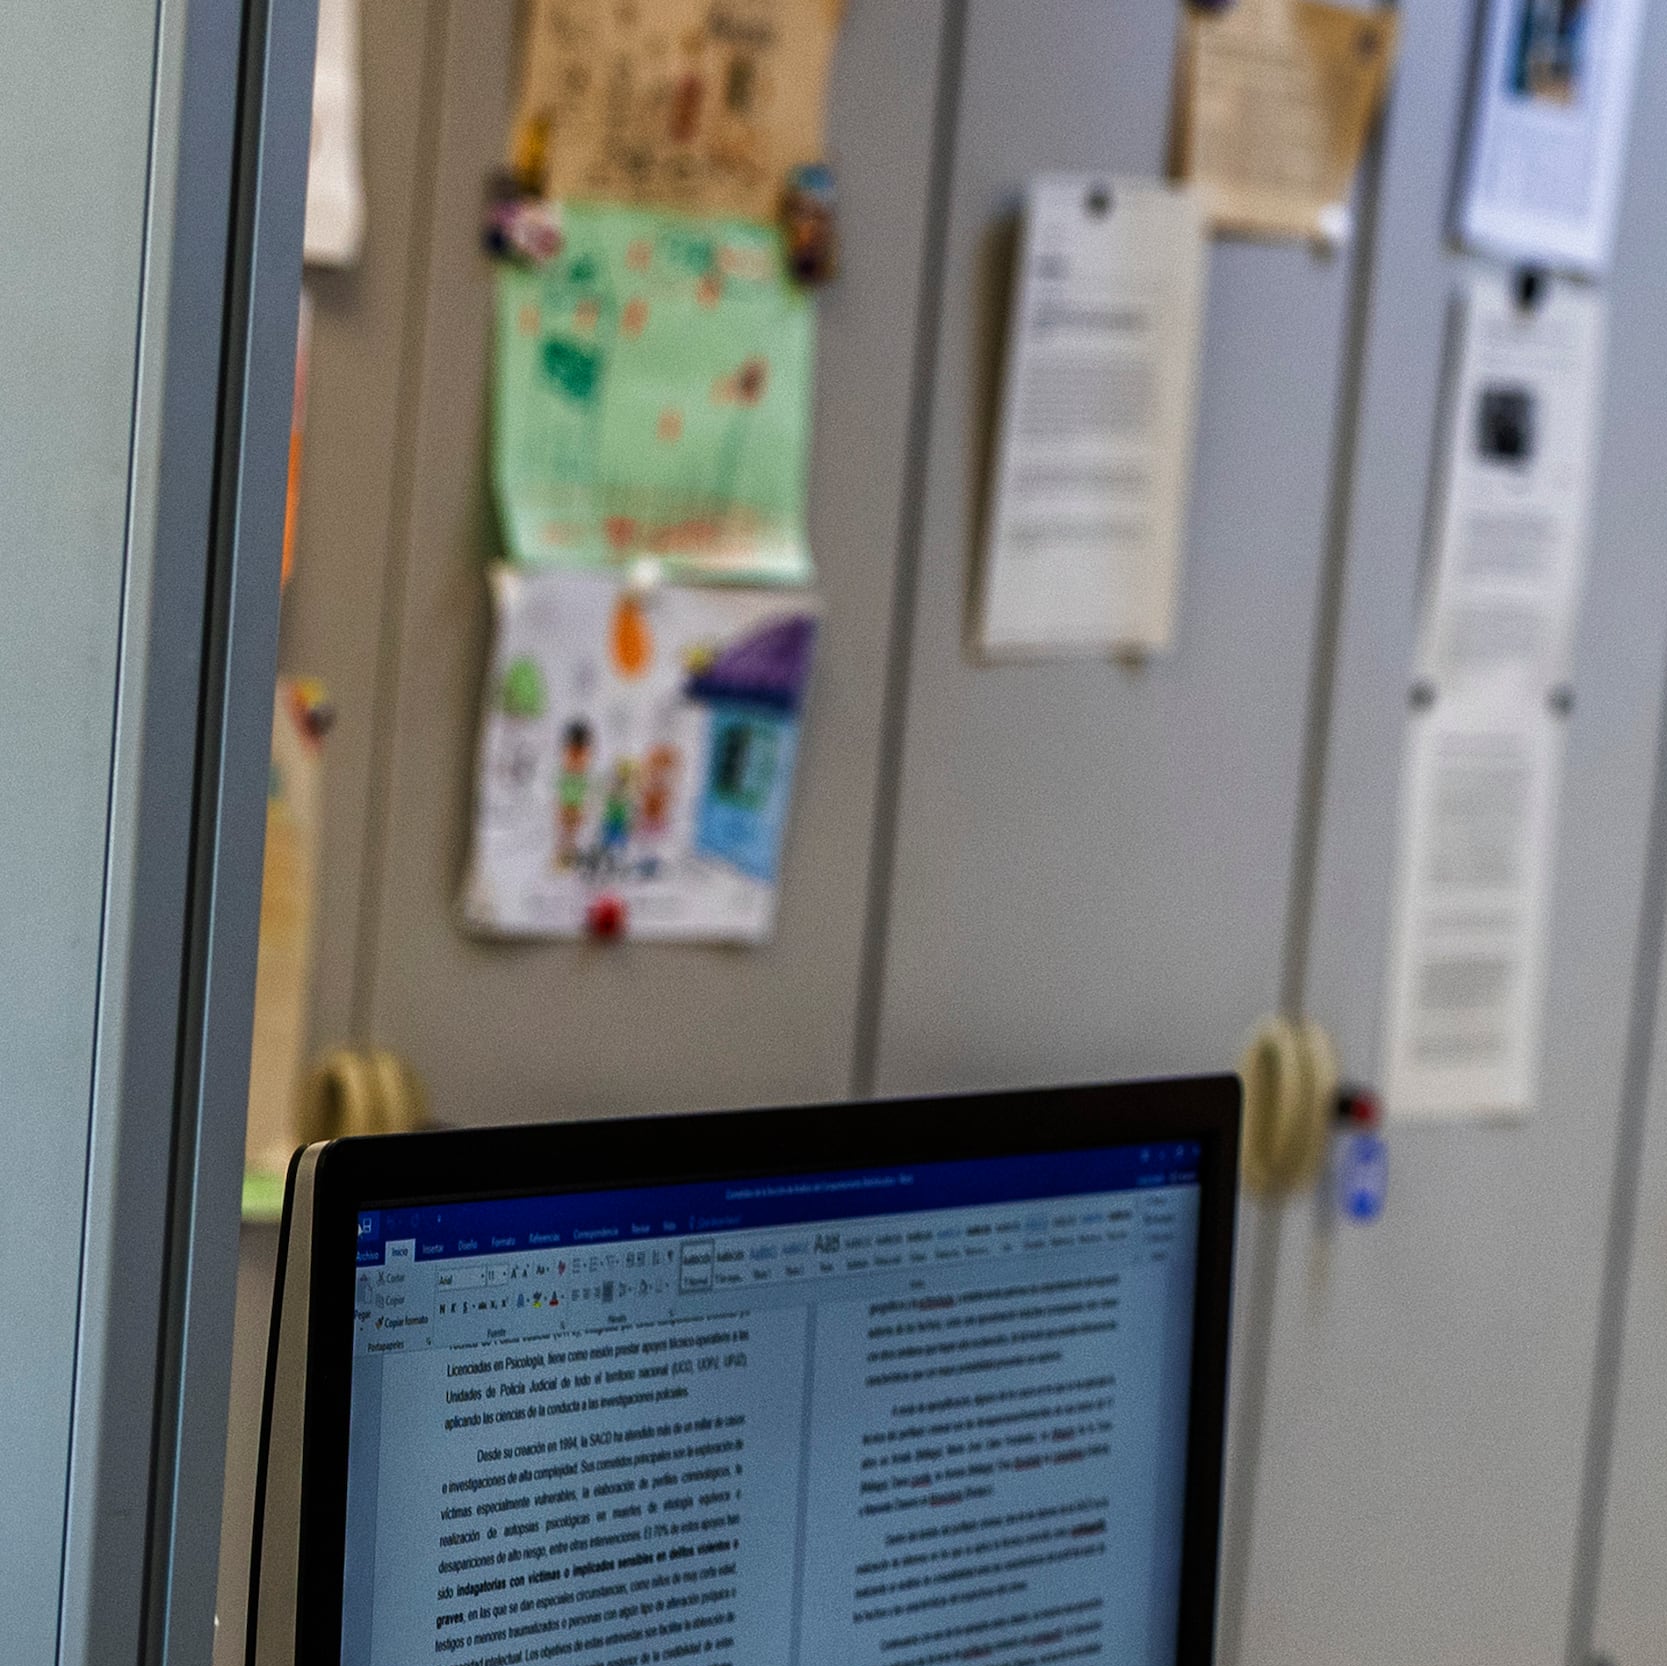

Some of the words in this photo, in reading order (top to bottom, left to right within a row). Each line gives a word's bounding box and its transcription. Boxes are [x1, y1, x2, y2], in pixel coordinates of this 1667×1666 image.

[392, 1247, 408, 1258] Inicio
[384, 1318, 404, 1329] Copiar
[405, 1315, 429, 1326] formato
[447, 1361, 491, 1376] Licenciadas
[493, 1360, 503, 1371] en
[446, 1388, 481, 1403] Unidades
[486, 1386, 495, 1398] de
[444, 1413, 480, 1430] aplicando
[483, 1412, 493, 1424] las
[495, 1409, 525, 1422] ciencias
[477, 1448, 501, 1462] Desde
[503, 1448, 512, 1458] su
[449, 1475, 505, 1492] investigaciones
[507, 1472, 516, 1483] de
[487, 1527, 496, 1539] de
[438, 1554, 494, 1573] desapariciones
[496, 1551, 505, 1563] de
[507, 1549, 521, 1561] alto
[437, 1586, 453, 1600] sido
[457, 1578, 505, 1596] indagatorias
[468, 1610, 477, 1620] en
[479, 1607, 490, 1618] las
[492, 1605, 506, 1618] que
[509, 1603, 517, 1613] se
[435, 1637, 464, 1652] testigos
[474, 1630, 505, 1644] menores
